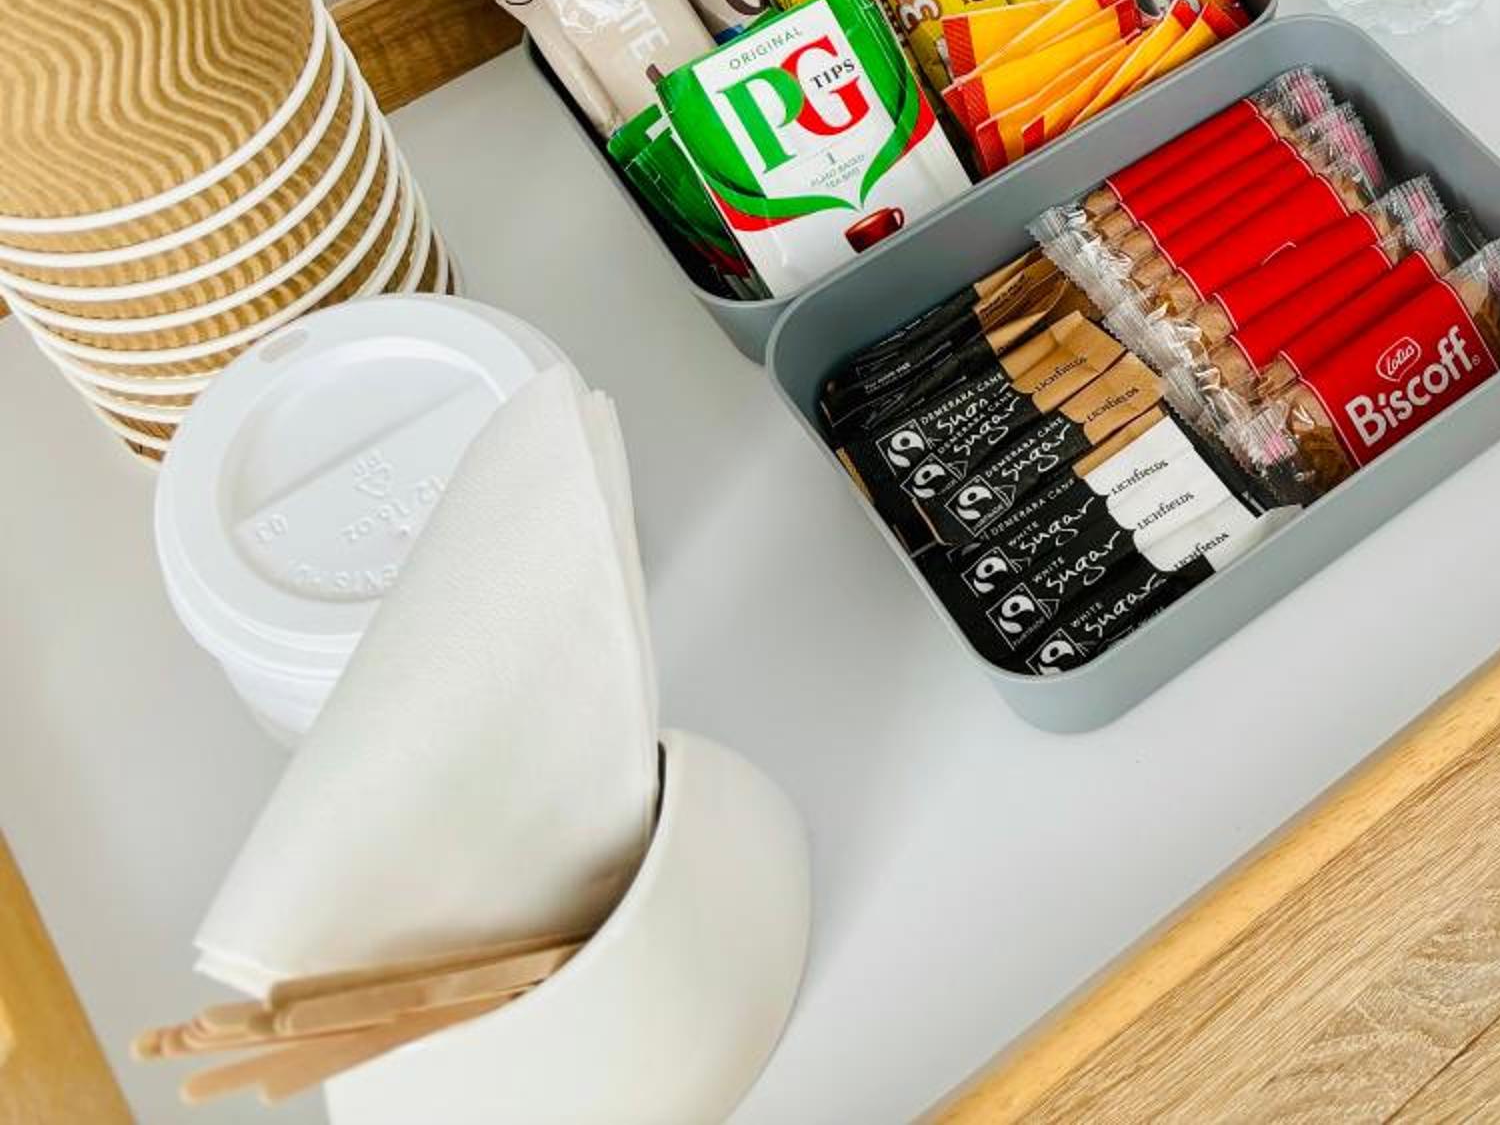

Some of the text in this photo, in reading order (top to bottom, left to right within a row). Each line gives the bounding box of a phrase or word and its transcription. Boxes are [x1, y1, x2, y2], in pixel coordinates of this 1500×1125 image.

[729, 27, 802, 70] ORIGINAL
[809, 58, 856, 89] TIPS
[716, 35, 870, 174] PG
[921, 373, 1005, 425] DEMERARA CANE
[1344, 325, 1474, 448] Biscoff
[953, 396, 1020, 456] sugar
[985, 416, 1065, 477] DEMERARA CANE
[1001, 424, 1071, 481] sugar
[990, 478, 1076, 535] DEMERARA CANE
[1008, 520, 1040, 546] WHITE
[1020, 496, 1096, 554] sugar
[1032, 556, 1065, 584] WHITE
[1046, 530, 1121, 594] sugar
[1070, 602, 1103, 627] WHITE
